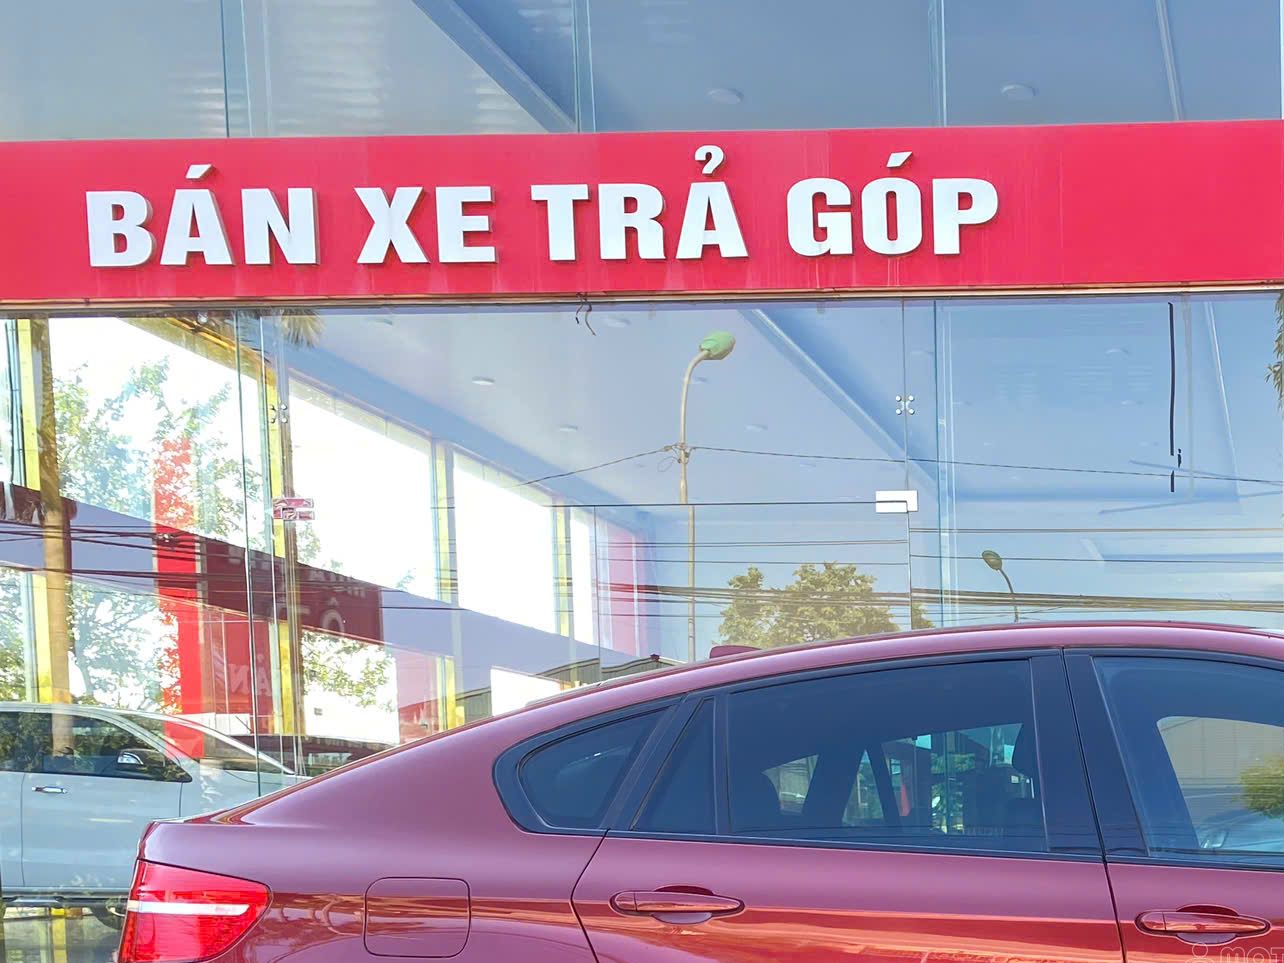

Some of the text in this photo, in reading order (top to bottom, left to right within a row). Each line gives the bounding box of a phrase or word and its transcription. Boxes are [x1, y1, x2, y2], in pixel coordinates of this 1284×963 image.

[85, 144, 999, 267] BÁN XE TRẢ GÓP
